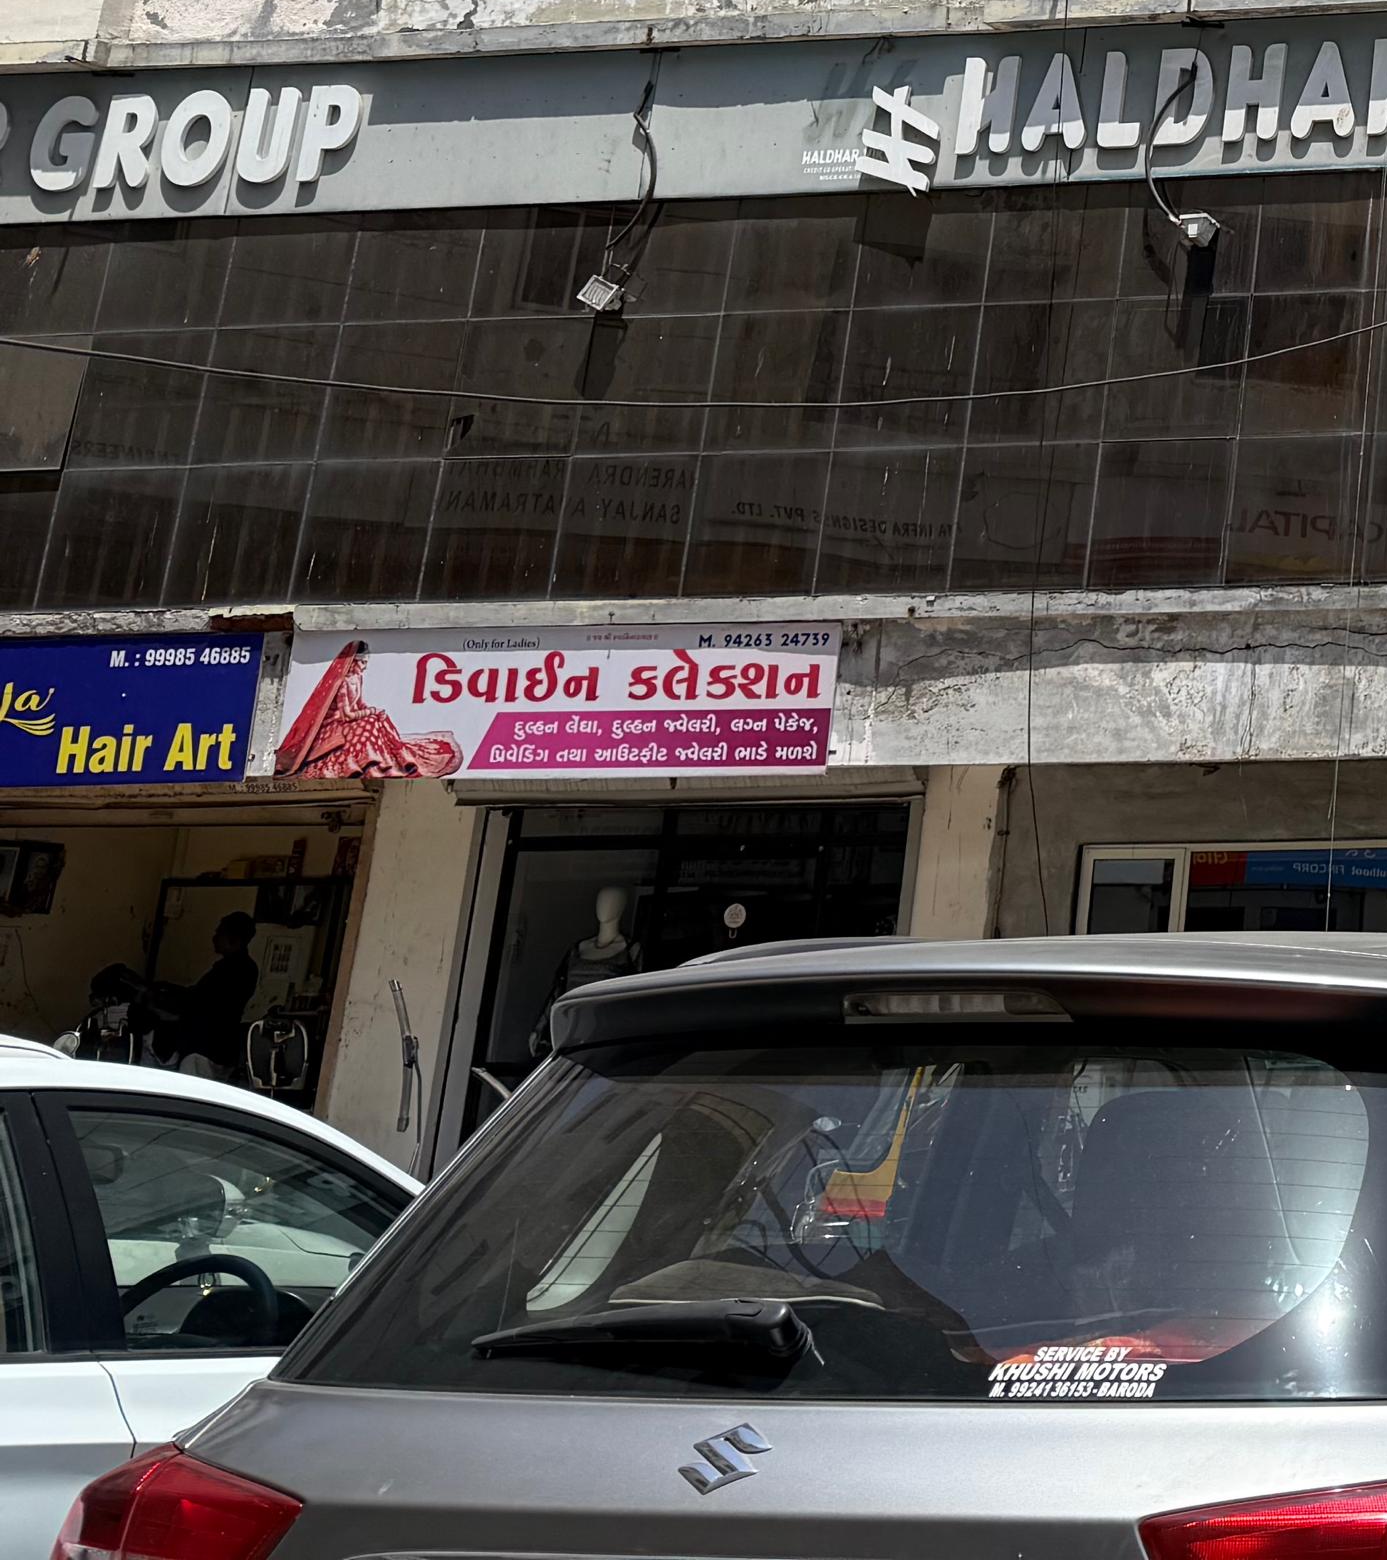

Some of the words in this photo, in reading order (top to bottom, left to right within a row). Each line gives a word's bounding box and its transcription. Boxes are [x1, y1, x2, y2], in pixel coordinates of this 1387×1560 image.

[30, 84, 363, 191] GROUP
[463, 638, 490, 652] (Only
[491, 637, 505, 649] for
[506, 636, 540, 650] Ladies)
[697, 634, 716, 648] M.
[724, 632, 773, 648] 94263
[780, 631, 831, 647] 24739
[145, 648, 196, 667] 99985
[199, 646, 251, 665] 46885
[513, 719, 559, 741] દુલ્હન
[611, 718, 657, 740] દુલ્હન
[56, 724, 152, 774] Hair
[163, 723, 237, 772] Art
[555, 749, 587, 763] તથા
[734, 741, 769, 762] ભાડે
[774, 740, 818, 762] મળશે
[1034, 1345, 1106, 1362] SERVICE
[1104, 1345, 1133, 1361] BY
[988, 1362, 1075, 1382] KHUSHI
[1074, 1362, 1168, 1382] MOTORS
[988, 1382, 1005, 1398] M.
